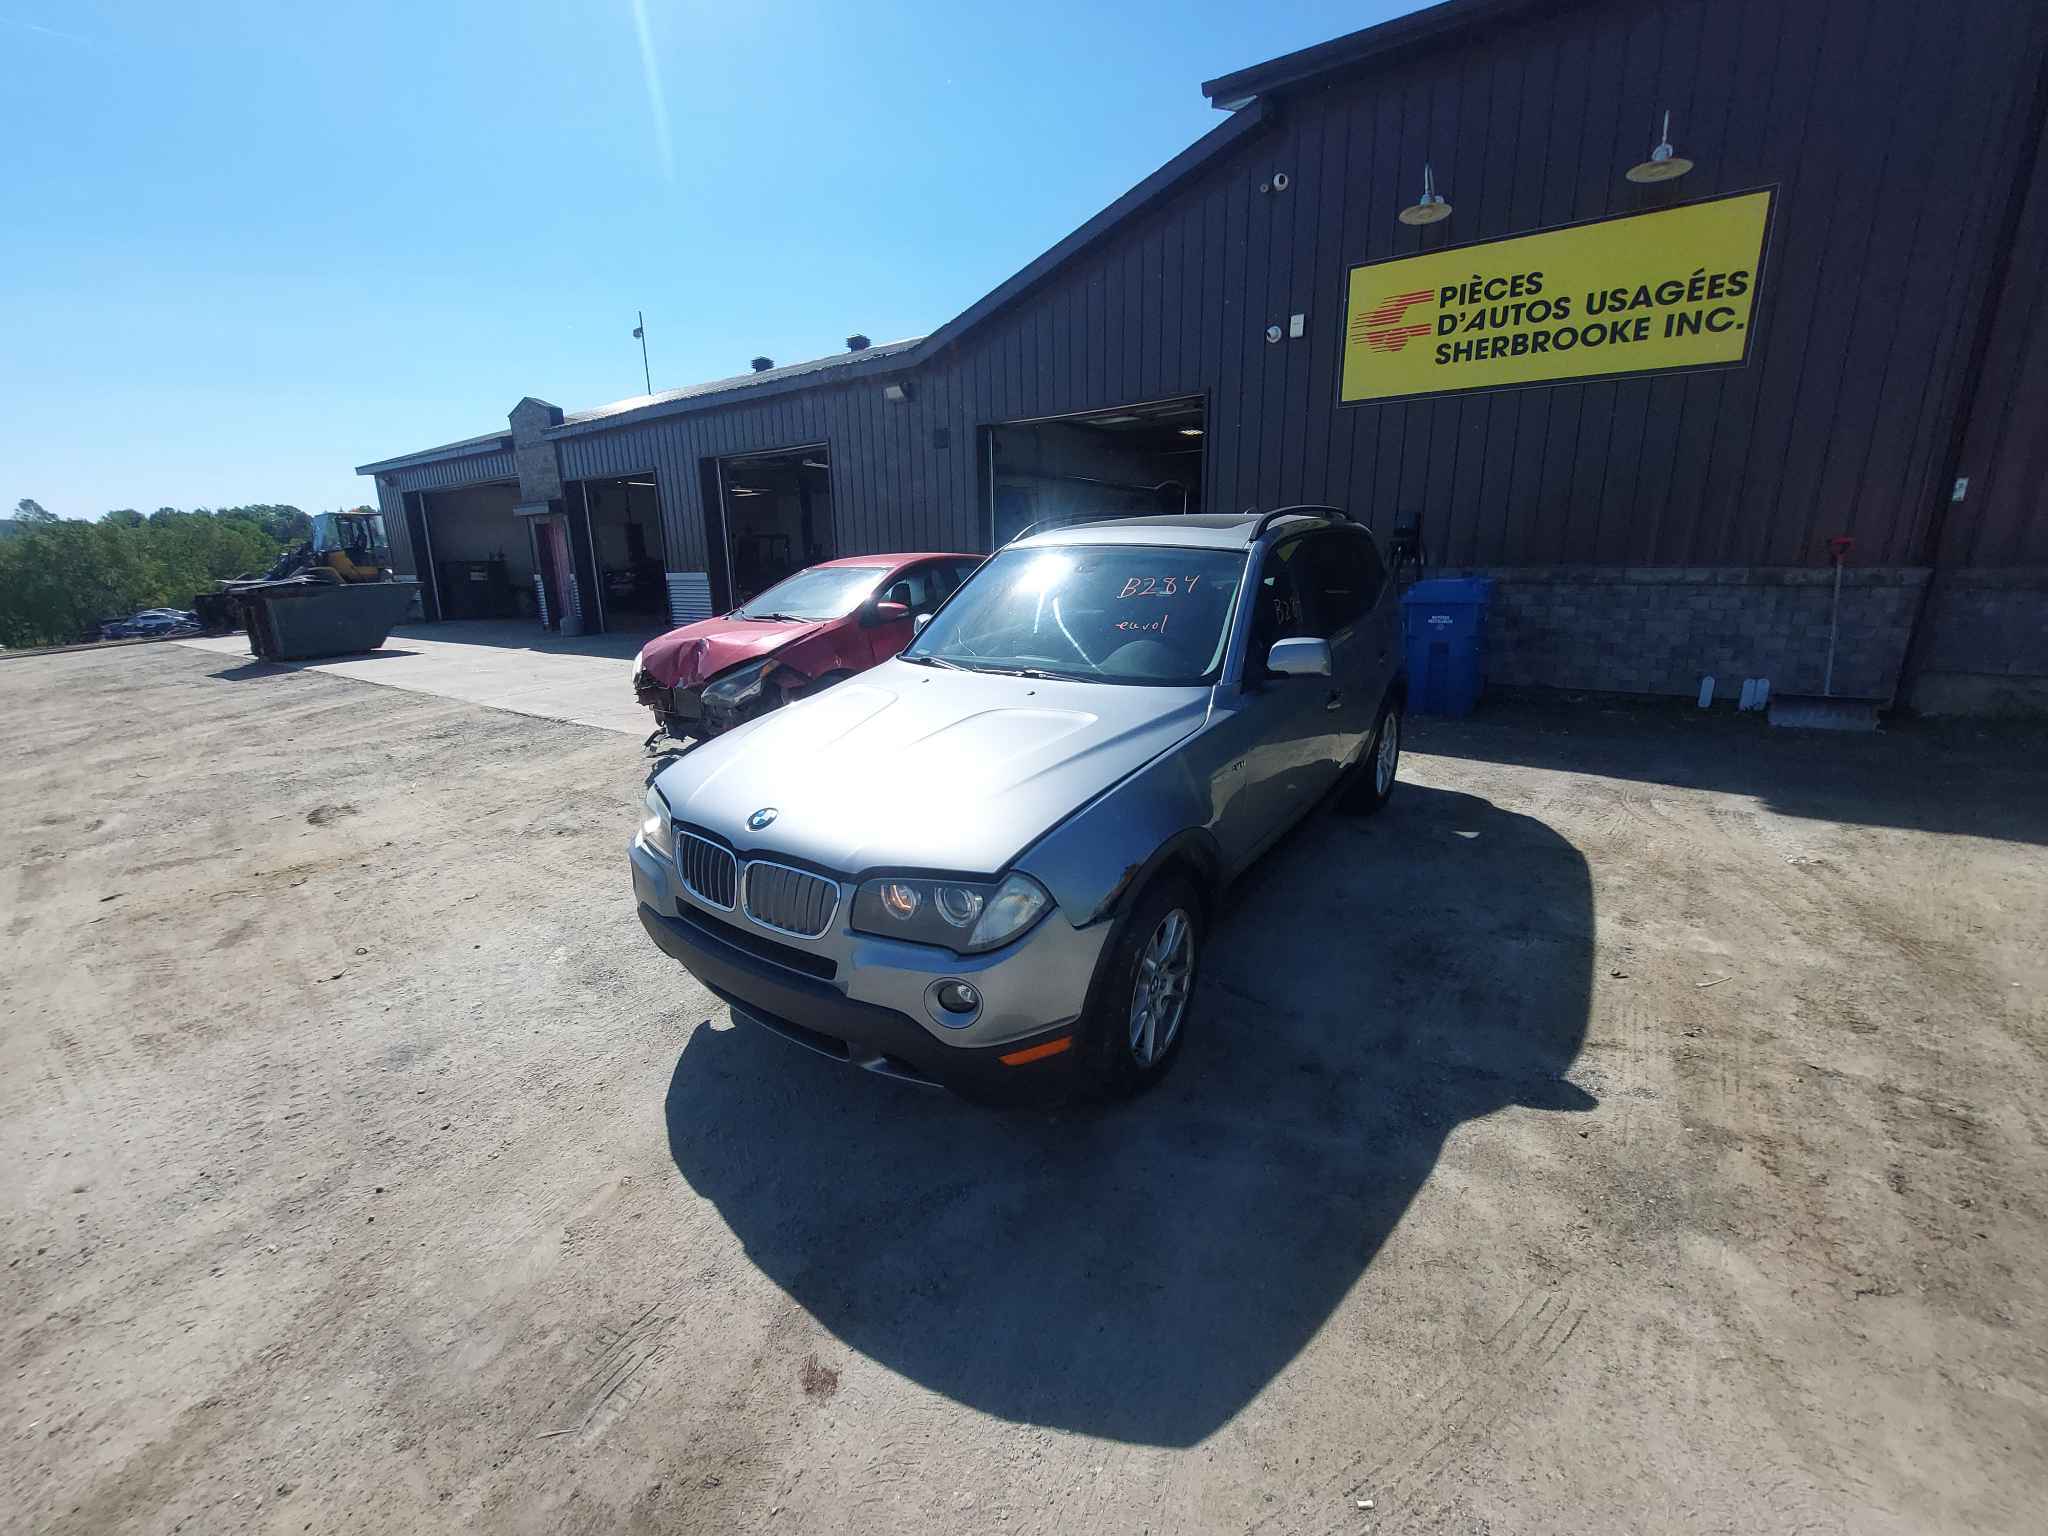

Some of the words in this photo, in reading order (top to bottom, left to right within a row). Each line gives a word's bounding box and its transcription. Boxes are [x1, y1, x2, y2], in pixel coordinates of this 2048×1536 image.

[1436, 297, 1571, 337] D'AUTOS
[1586, 268, 1749, 315] USAGÉES
[1439, 272, 1544, 309] PIÈCES
[1434, 317, 1649, 365] SHERBROOKE
[1664, 306, 1745, 339] INC.
